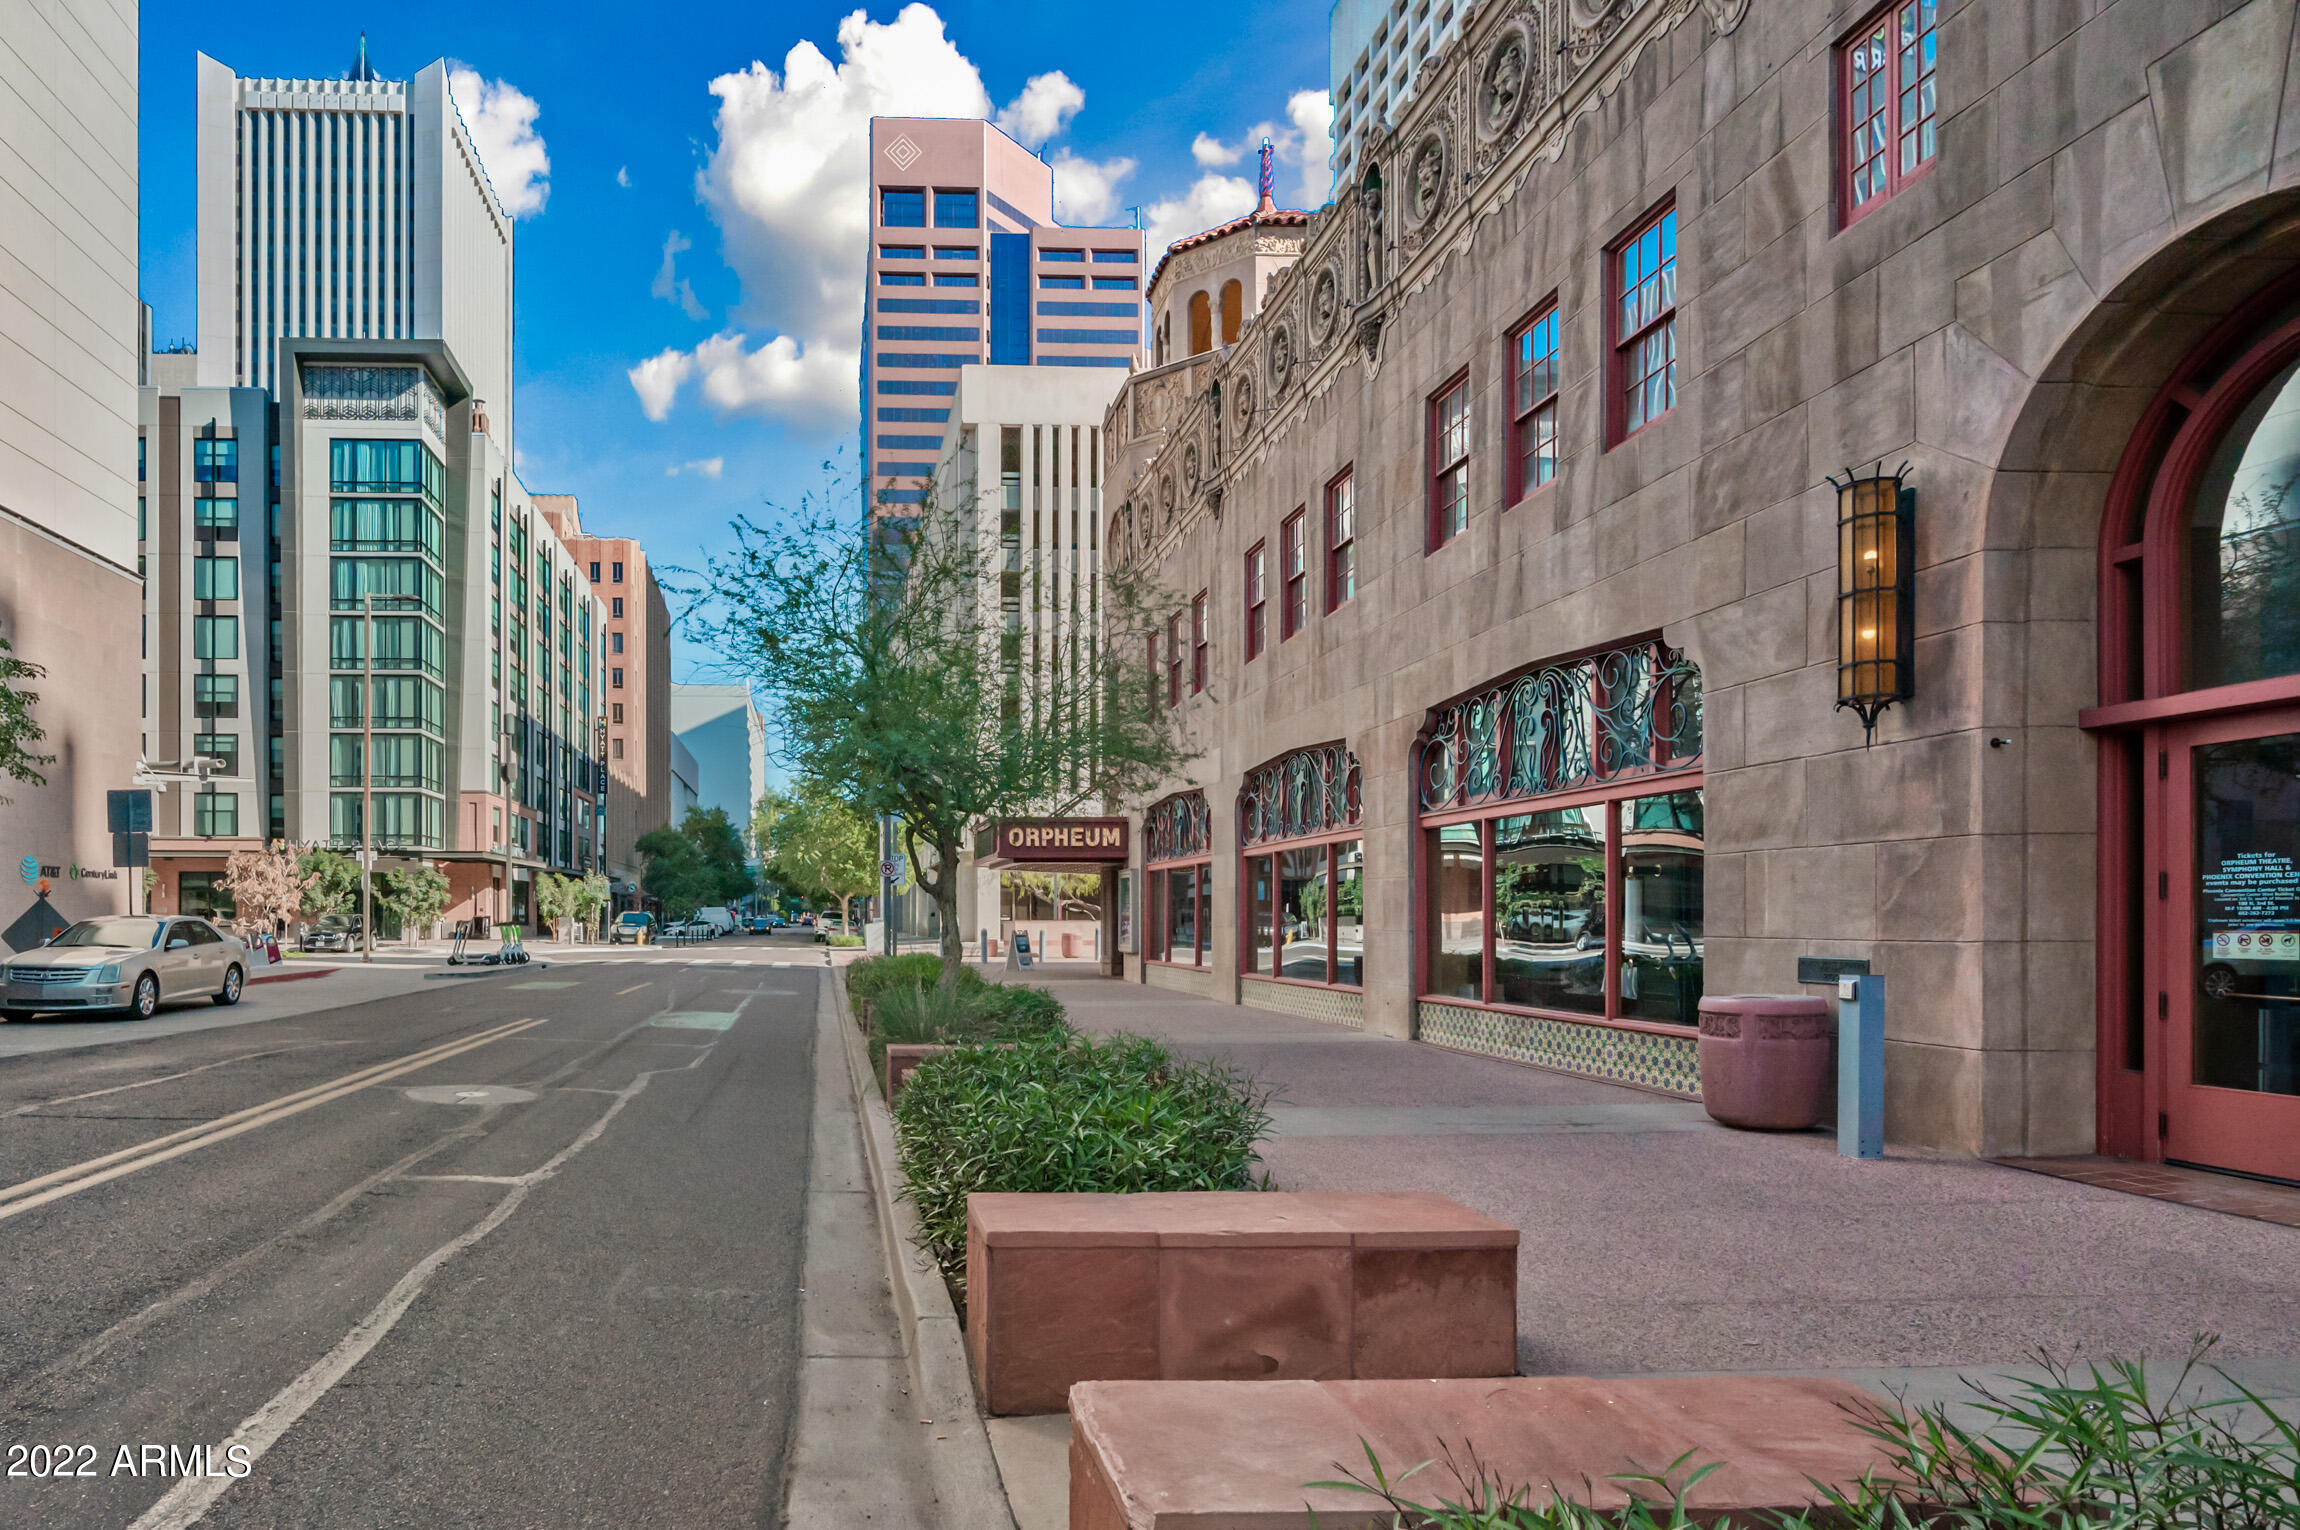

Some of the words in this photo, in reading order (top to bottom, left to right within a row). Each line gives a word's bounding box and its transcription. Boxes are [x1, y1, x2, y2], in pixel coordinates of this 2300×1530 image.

[1008, 827, 1120, 847] ORPHEUM
[40, 866, 61, 878] AT&T
[80, 867, 118, 880] CenturyLink
[2222, 865, 2263, 873] SYMPHONY
[2258, 878, 2299, 886] purchased
